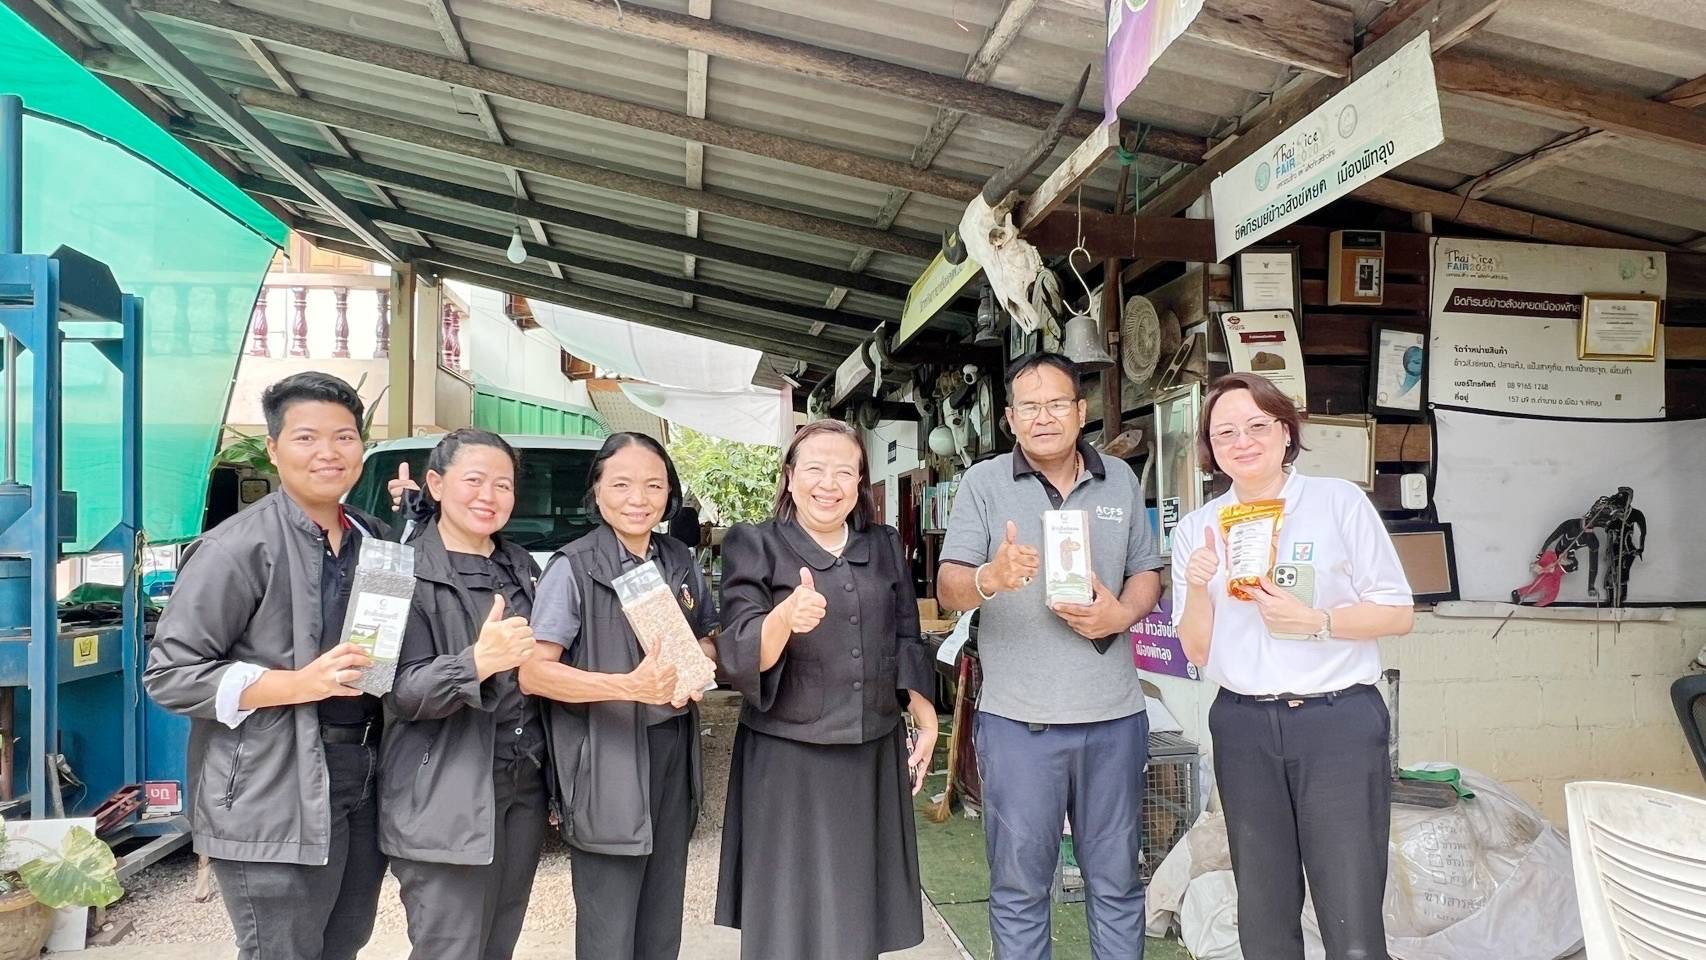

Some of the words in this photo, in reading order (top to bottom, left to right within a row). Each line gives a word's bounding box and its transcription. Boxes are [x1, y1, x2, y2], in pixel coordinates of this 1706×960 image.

[1272, 141, 1295, 165] Thai
[1337, 140, 1395, 185] เมืองพัทลุง
[1444, 249, 1469, 263] Thai
[1095, 505, 1123, 516] ACFS
